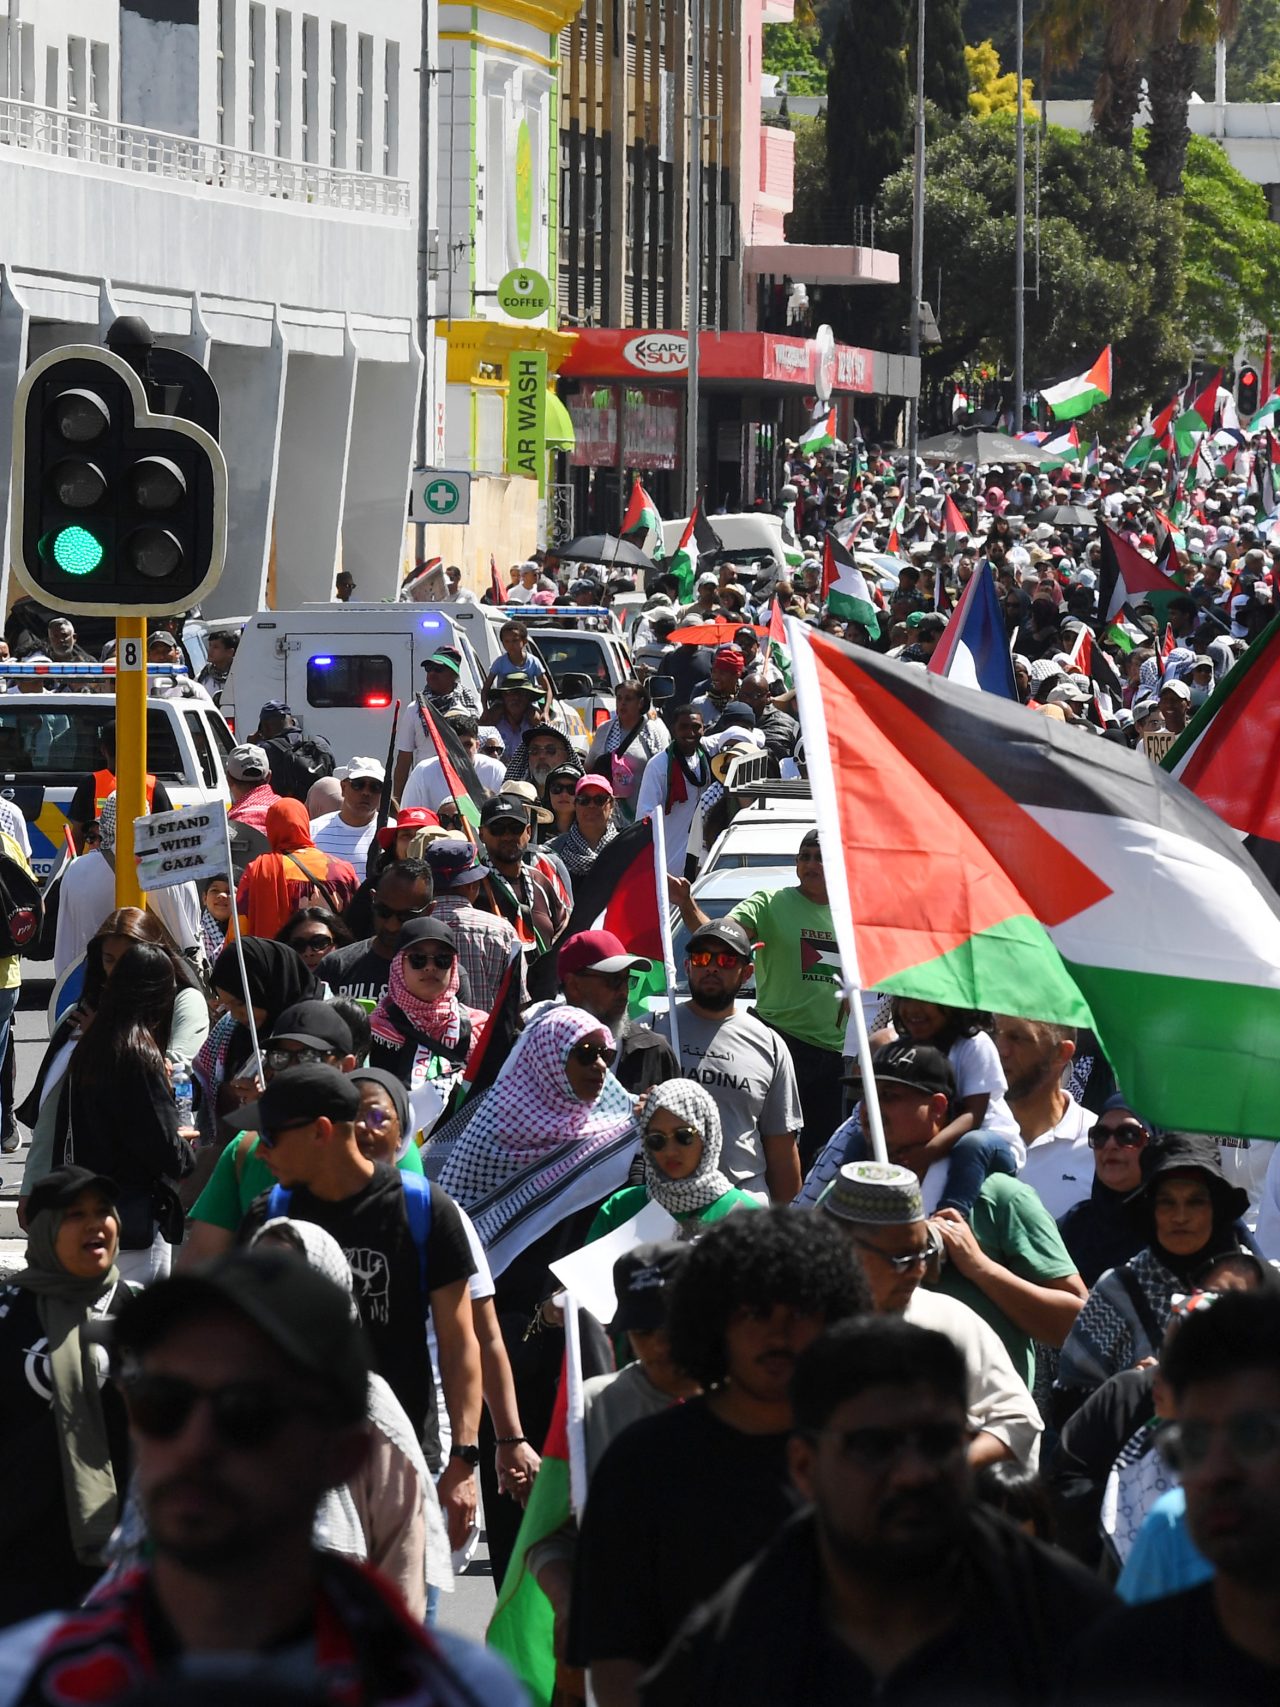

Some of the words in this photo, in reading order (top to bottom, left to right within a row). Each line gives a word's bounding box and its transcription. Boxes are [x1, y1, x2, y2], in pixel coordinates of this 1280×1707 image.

[503, 297, 544, 308] COFFEE
[646, 342, 687, 353] CAPE
[647, 352, 687, 365] SUV
[518, 360, 538, 431] WASH
[125, 642, 137, 666] 8
[148, 825, 154, 837] I
[157, 815, 210, 834] STAND
[160, 835, 202, 852] WITH
[162, 854, 206, 872] GAZA
[801, 928, 833, 941] FREE
